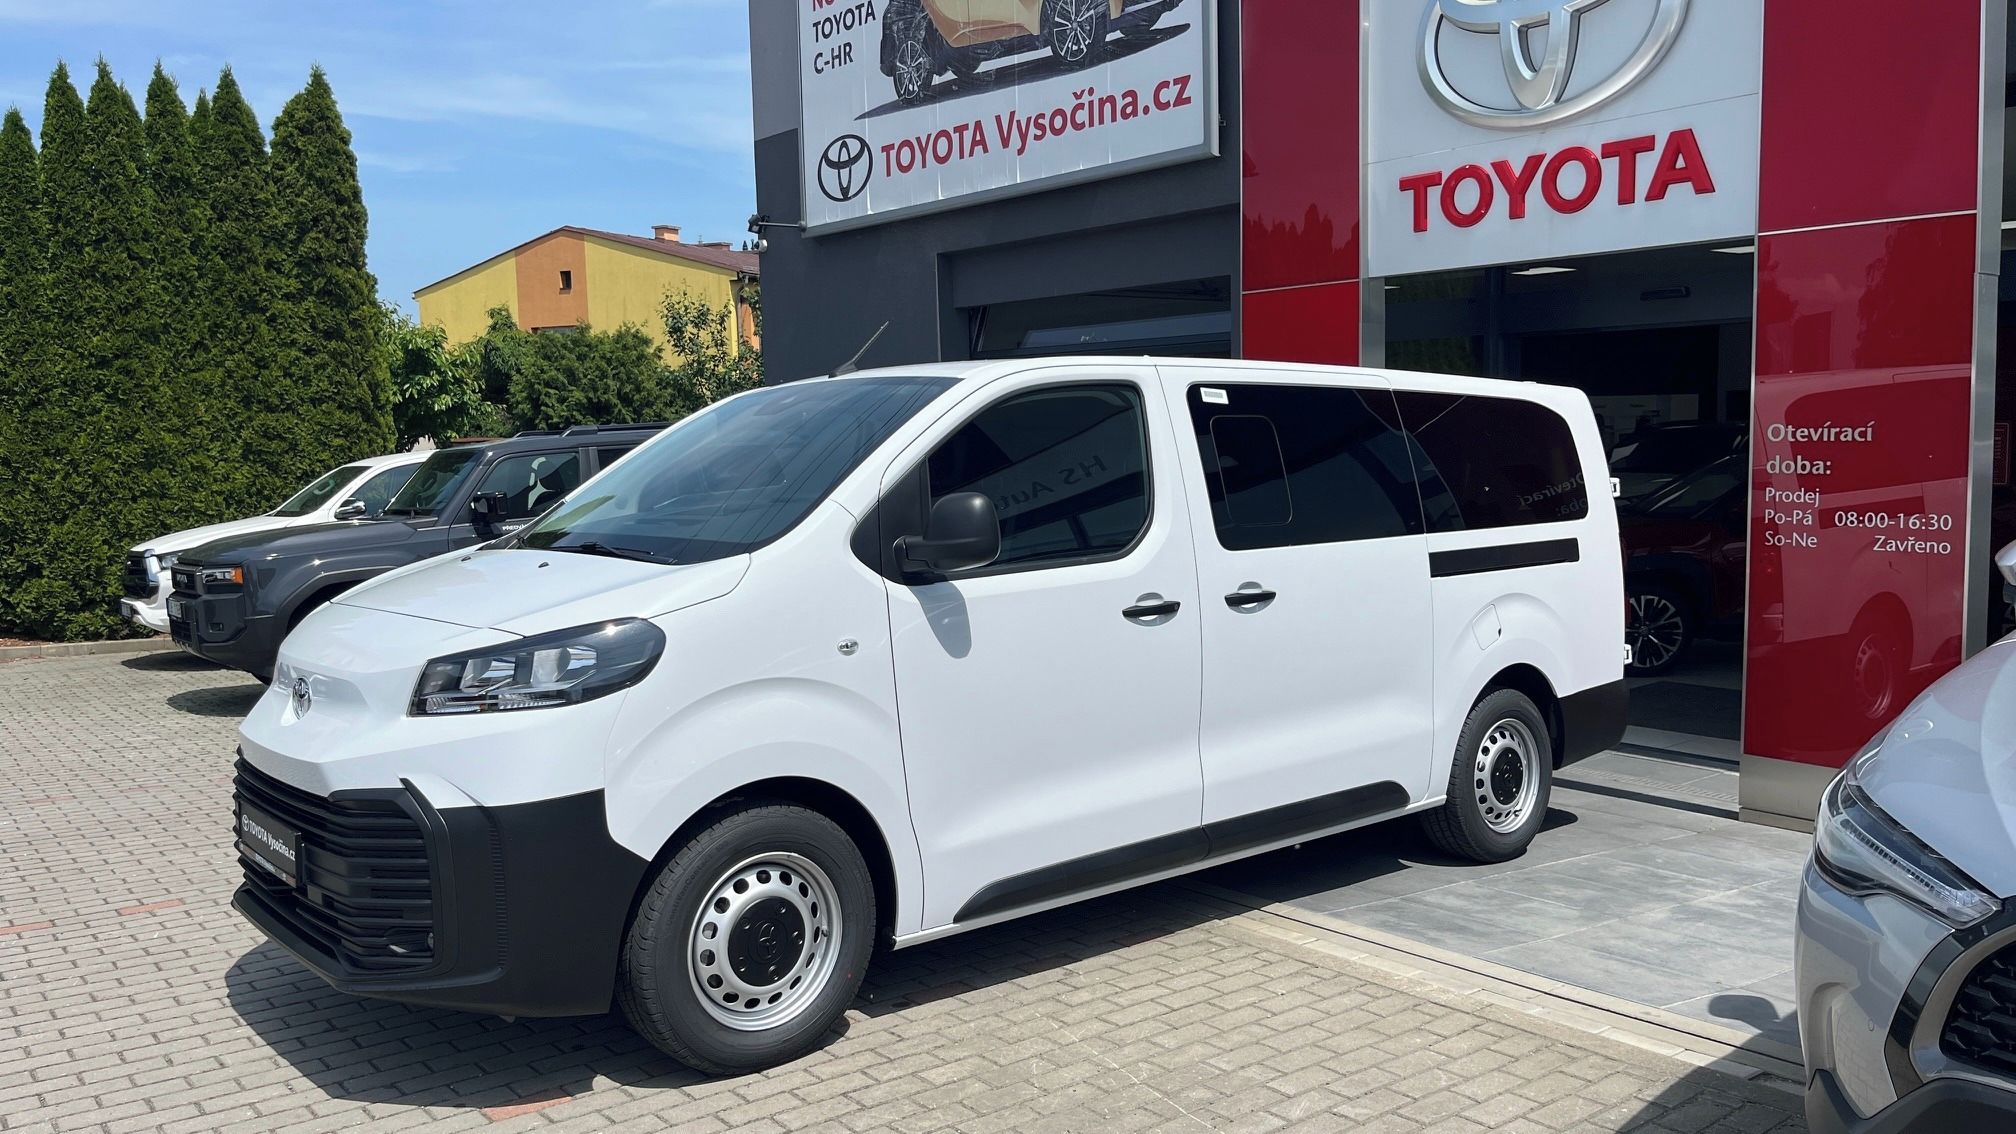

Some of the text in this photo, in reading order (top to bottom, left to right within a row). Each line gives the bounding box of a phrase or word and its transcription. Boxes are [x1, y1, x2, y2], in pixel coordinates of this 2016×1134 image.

[812, 0, 876, 43] TOYOTA
[813, 41, 854, 75] C-HR
[881, 74, 1193, 178] TOYOTA Vysočina.cz
[1399, 128, 1716, 233] TOYOTA
[1766, 421, 1875, 442] Otevírací
[1766, 455, 1832, 475] doba:
[1765, 487, 1820, 508] Prodej
[1765, 509, 1952, 531] Po-Pá 08:00-16:30
[1765, 531, 1951, 555] So-Ne Zavřeno
[249, 820, 268, 844] TOYOTA
